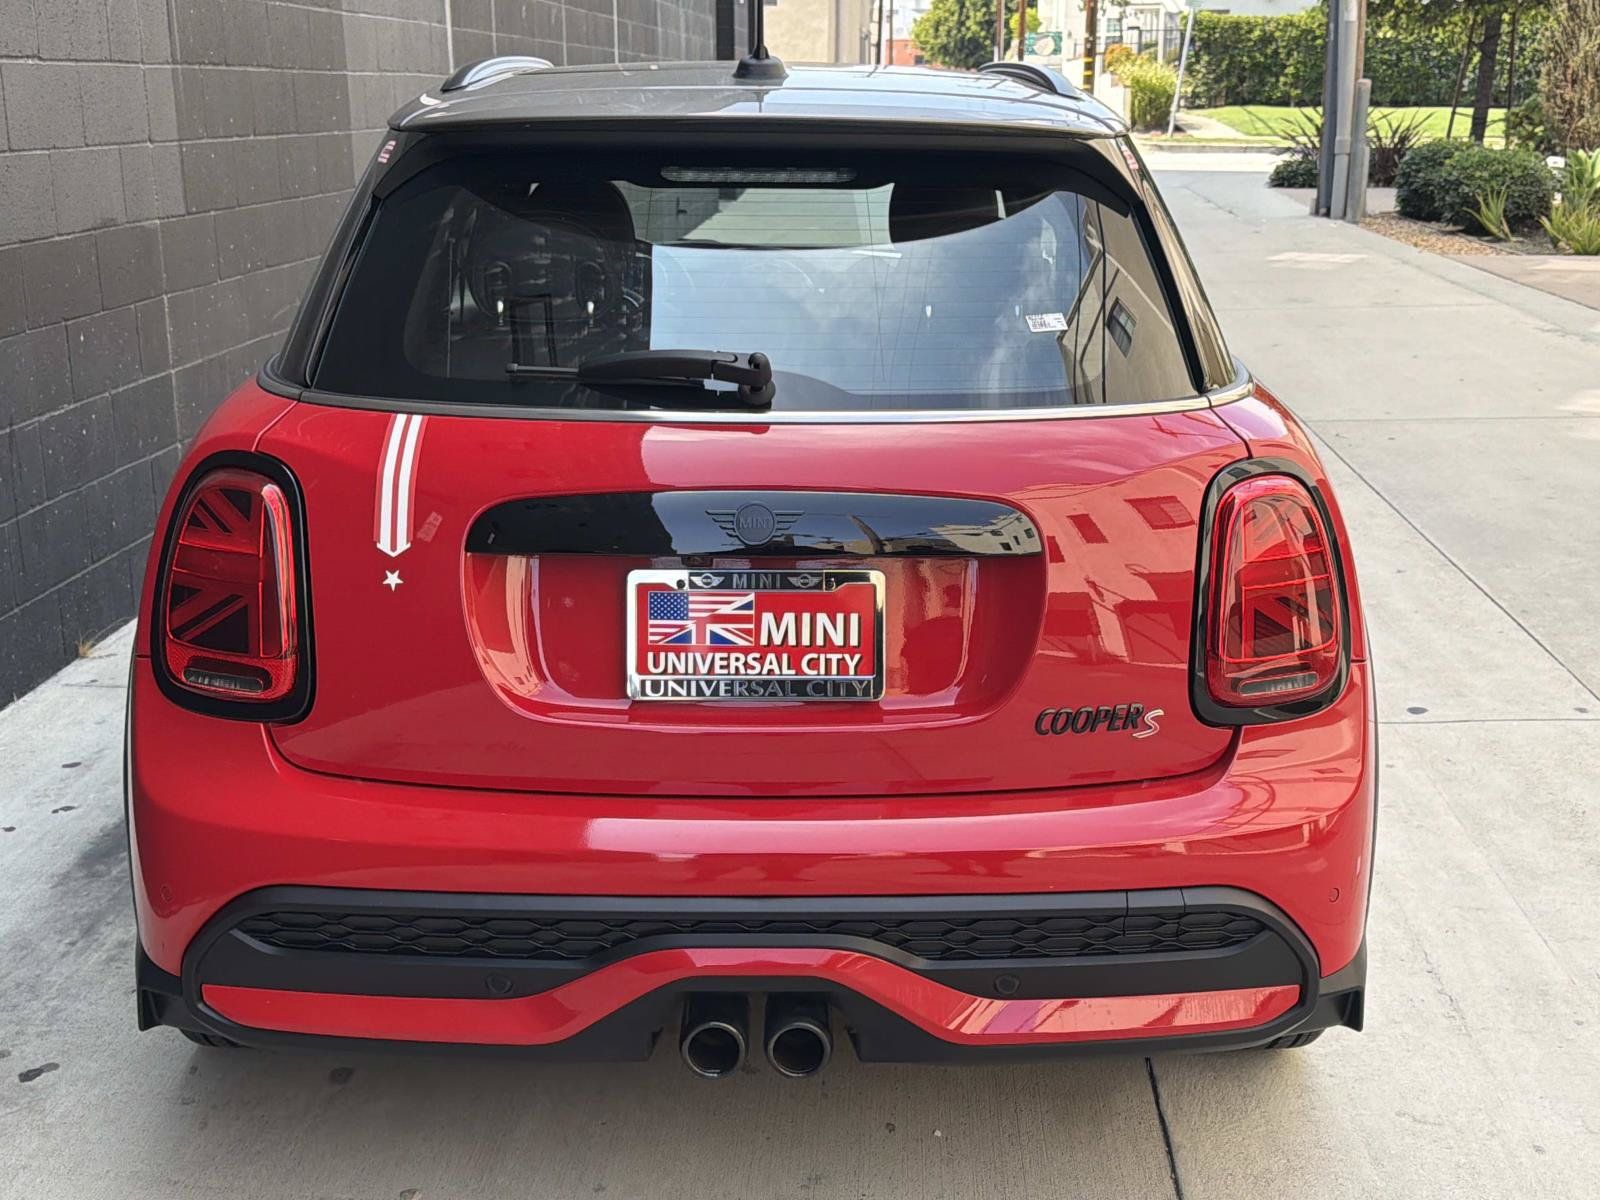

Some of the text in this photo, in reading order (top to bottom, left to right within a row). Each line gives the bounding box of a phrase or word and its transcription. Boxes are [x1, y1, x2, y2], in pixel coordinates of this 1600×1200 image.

[739, 516, 772, 529] MINI
[732, 573, 781, 589] MINI
[759, 612, 860, 647] MINI
[647, 651, 862, 676] UNIVERSAL CITY
[644, 679, 869, 697] UNIVERSAL CITY
[1034, 702, 1166, 739] COOPER S
